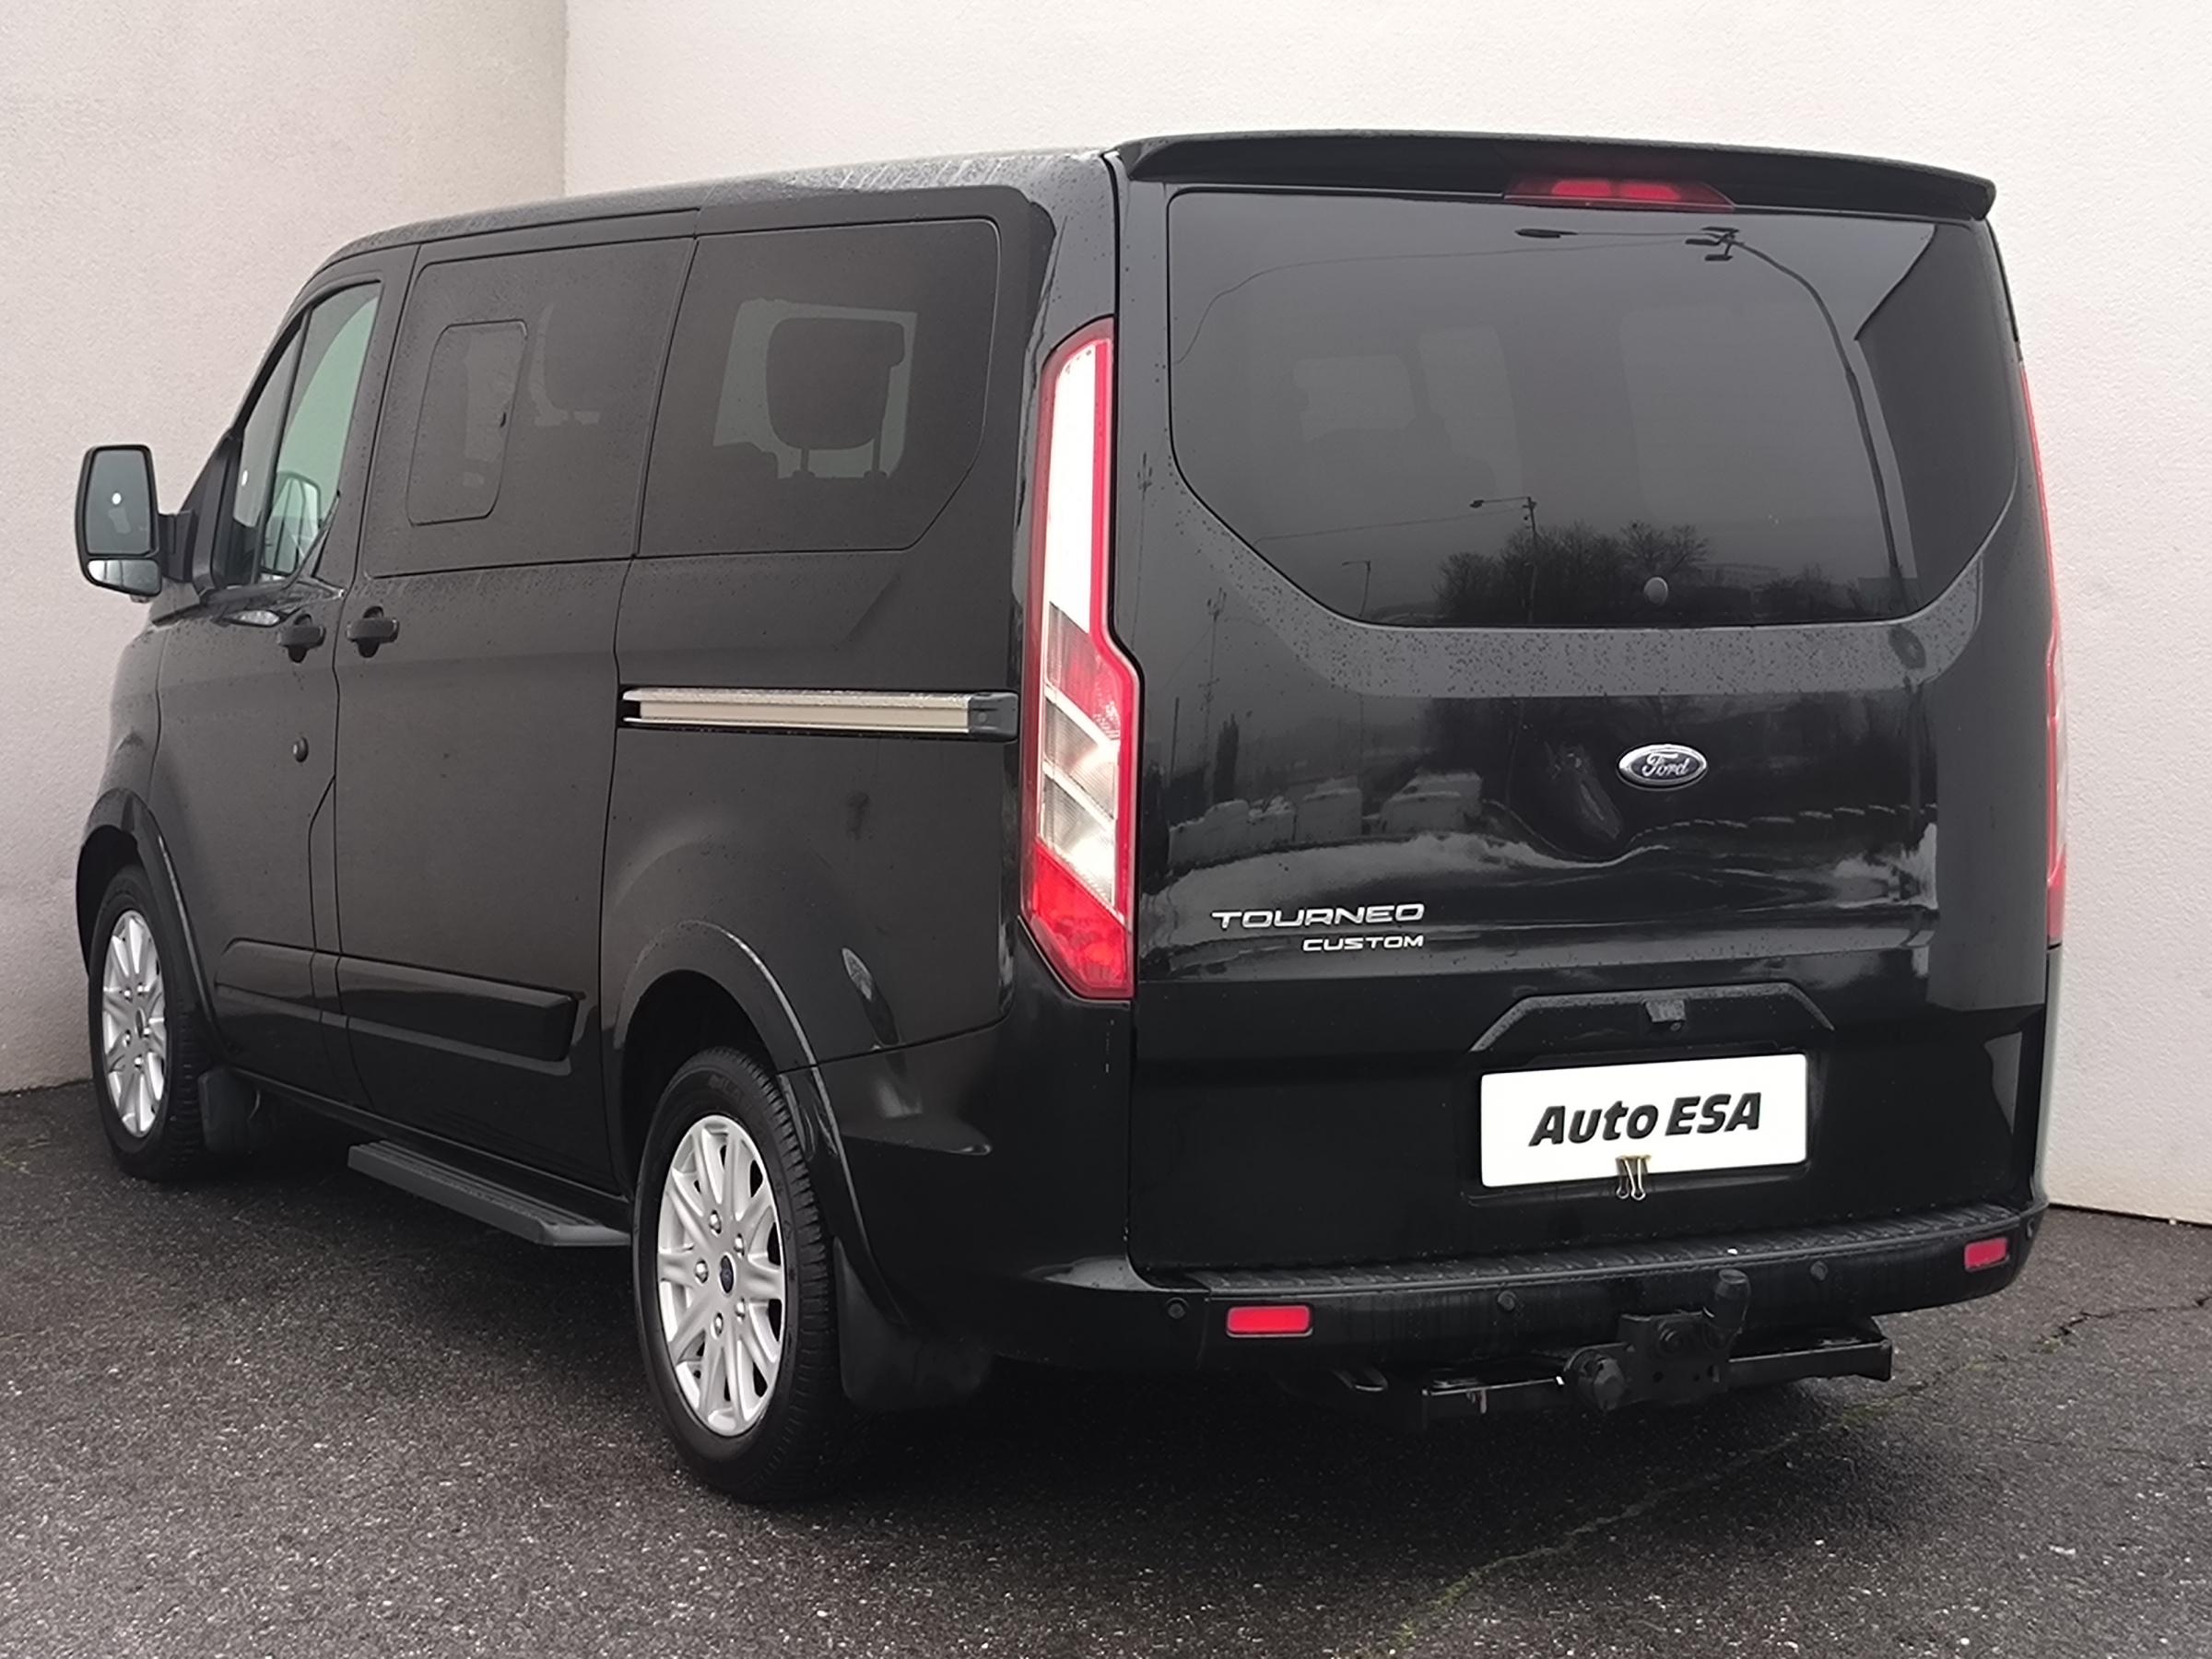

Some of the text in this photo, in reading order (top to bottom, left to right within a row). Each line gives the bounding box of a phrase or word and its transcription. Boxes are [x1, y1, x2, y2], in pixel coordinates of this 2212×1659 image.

[1641, 752, 1690, 777] Ford
[1211, 903, 1425, 929] TOURNEO
[1302, 935, 1424, 952] CUSTOM
[1528, 1091, 1761, 1147] Auto ESA
